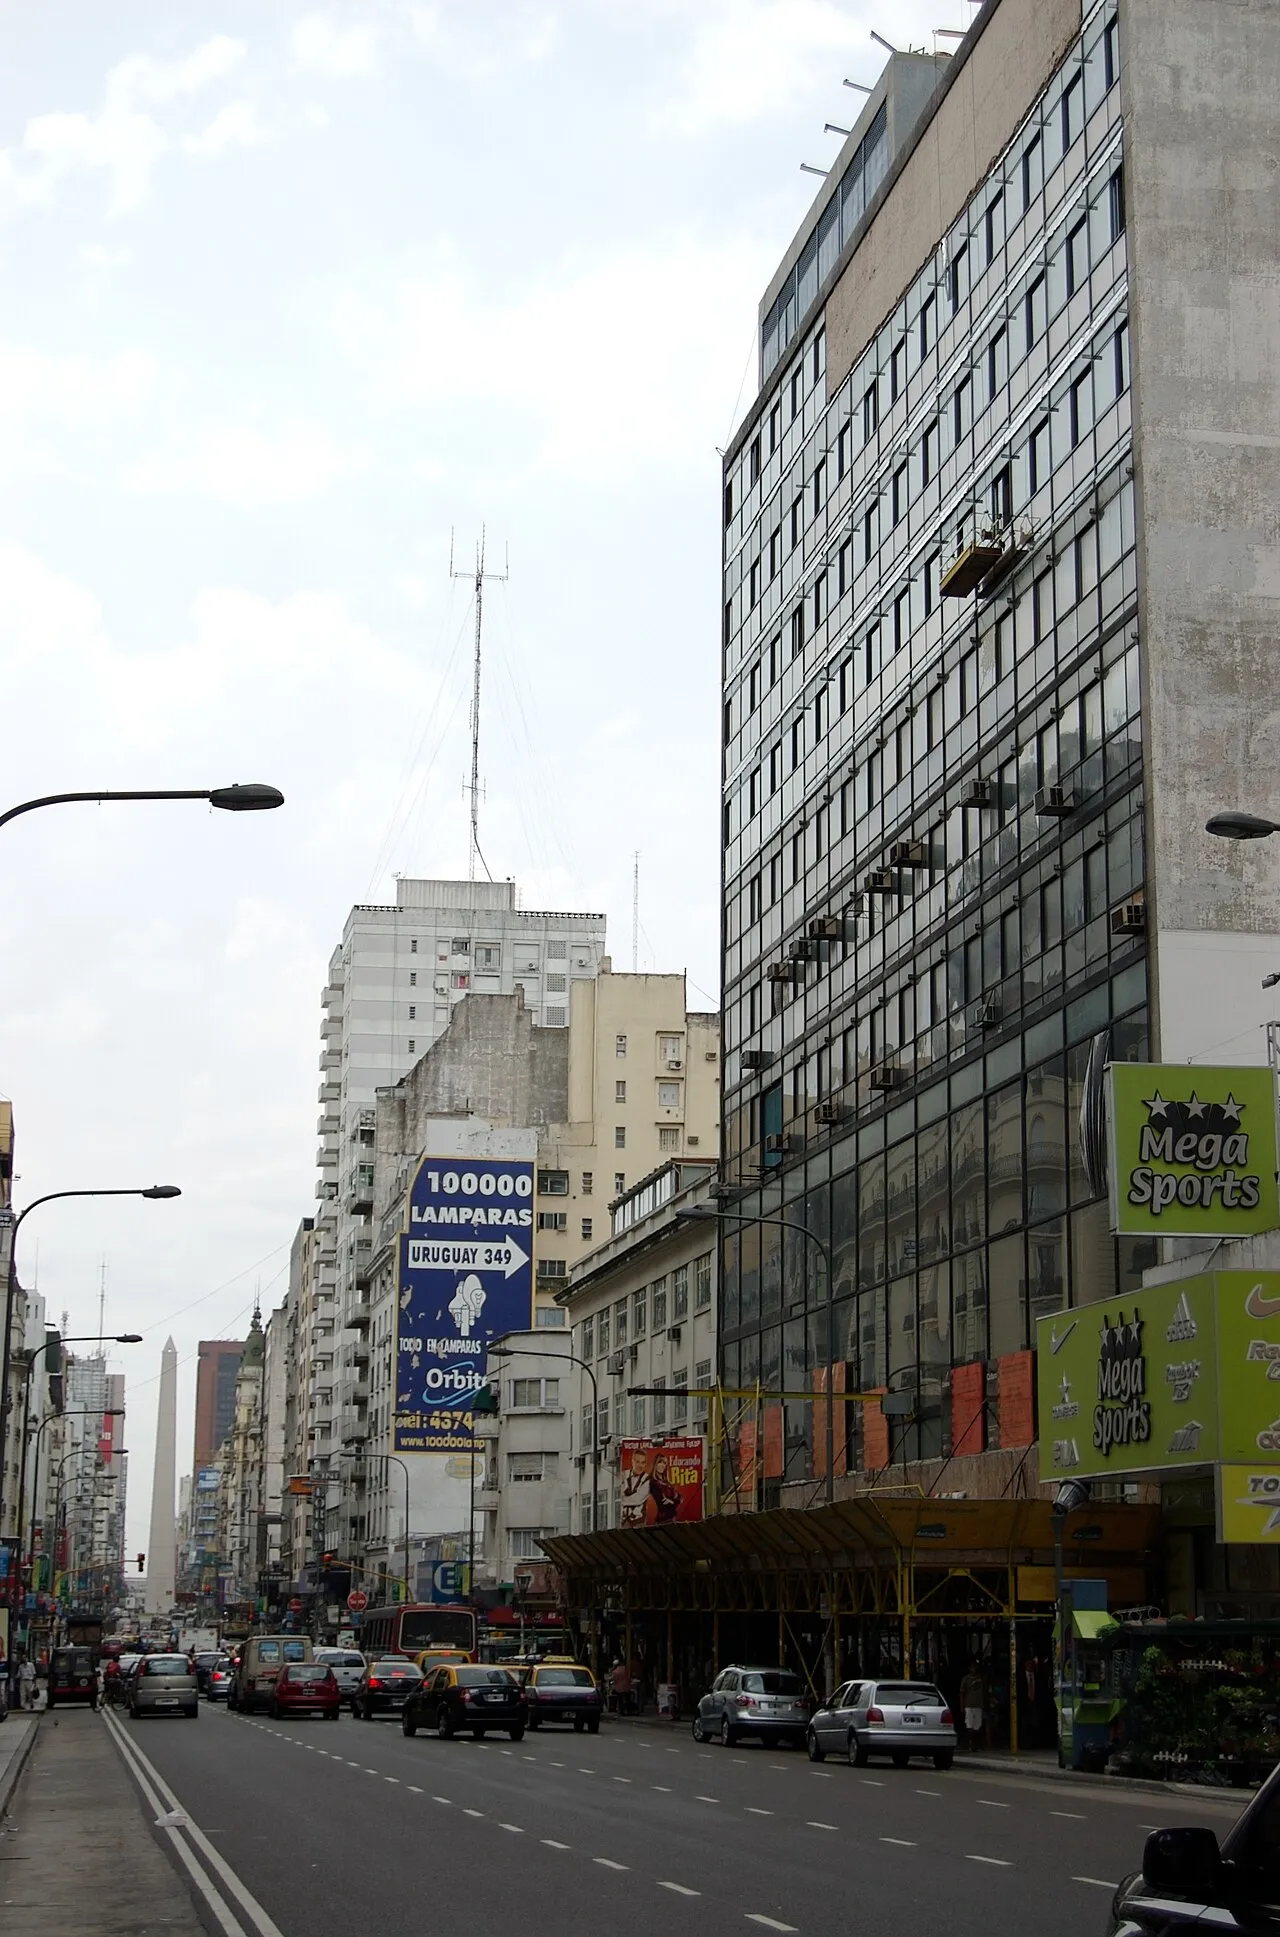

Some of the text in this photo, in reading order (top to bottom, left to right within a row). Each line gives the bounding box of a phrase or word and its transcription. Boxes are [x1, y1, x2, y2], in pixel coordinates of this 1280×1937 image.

[1139, 1124, 1249, 1172] Mega
[427, 1171, 533, 1198] 100000
[1127, 1166, 1260, 1215] Sports
[411, 1205, 533, 1227] LAMPARAS
[412, 1246, 512, 1265] URUGUAY 349
[399, 1337, 422, 1353] TODO
[1096, 1356, 1147, 1404] Mega
[1093, 1398, 1152, 1457] Sports
[669, 1454, 701, 1467] Educando
[670, 1466, 699, 1487] Rita
